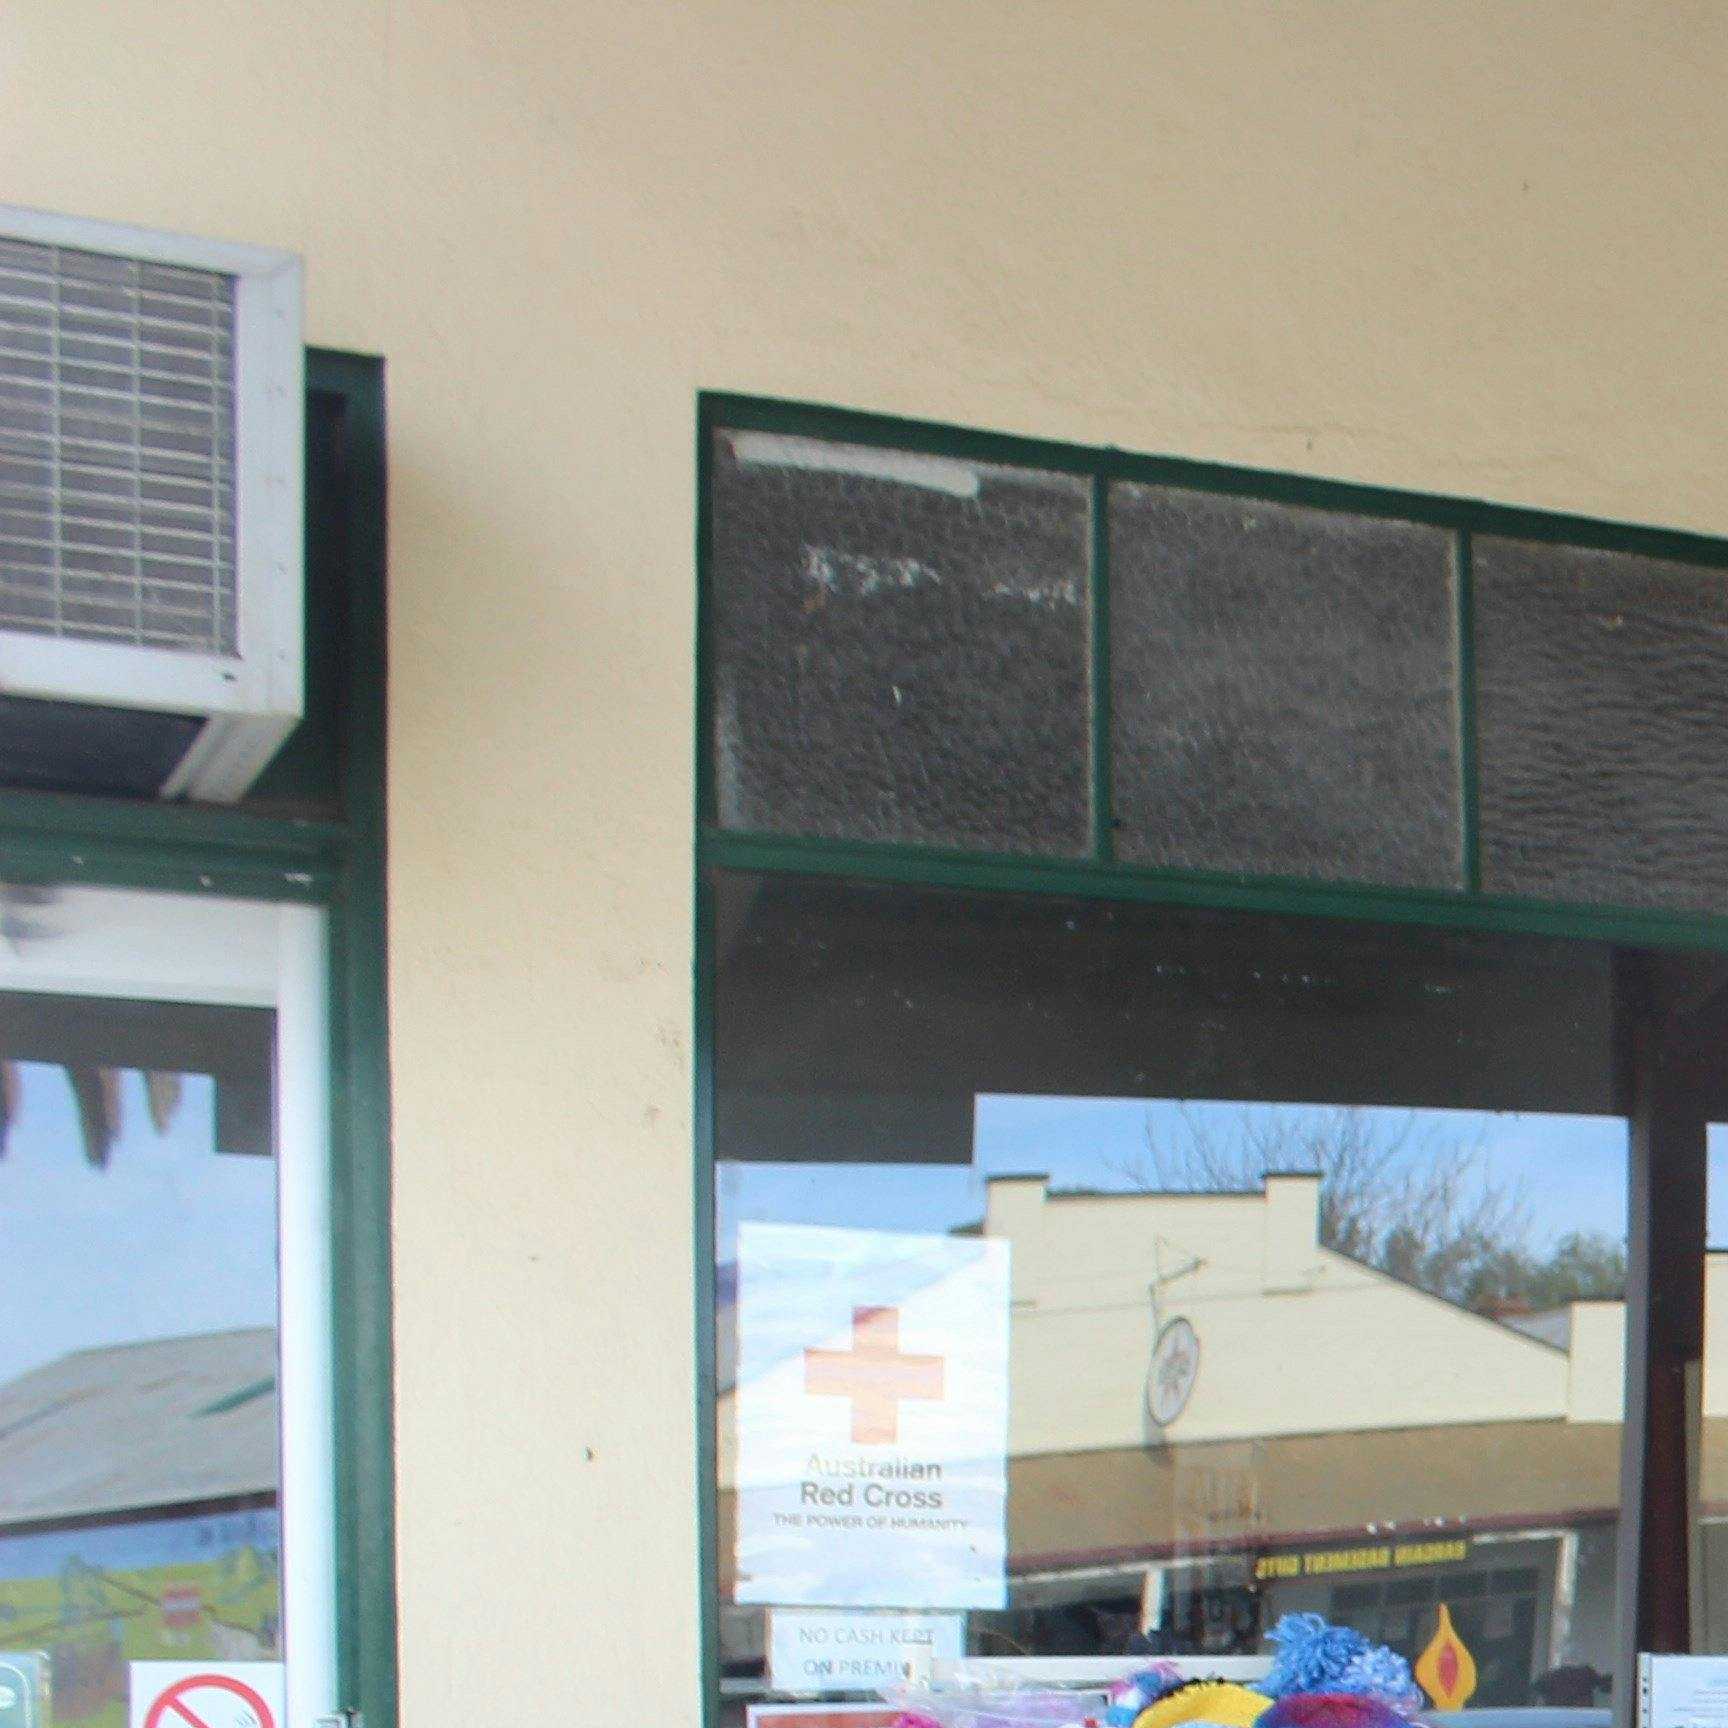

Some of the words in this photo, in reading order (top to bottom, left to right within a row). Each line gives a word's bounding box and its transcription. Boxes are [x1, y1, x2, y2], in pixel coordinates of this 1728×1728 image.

[807, 1453, 943, 1480] Australian
[801, 1481, 855, 1507] Red
[864, 1482, 944, 1510] Cross
[774, 1512, 802, 1528] THE
[806, 1514, 862, 1529] POWER
[867, 1516, 887, 1530] OF
[891, 1517, 969, 1531] HUMANITY
[799, 1627, 829, 1645] NO
[834, 1627, 885, 1645] CASH
[802, 1657, 833, 1677] ON
